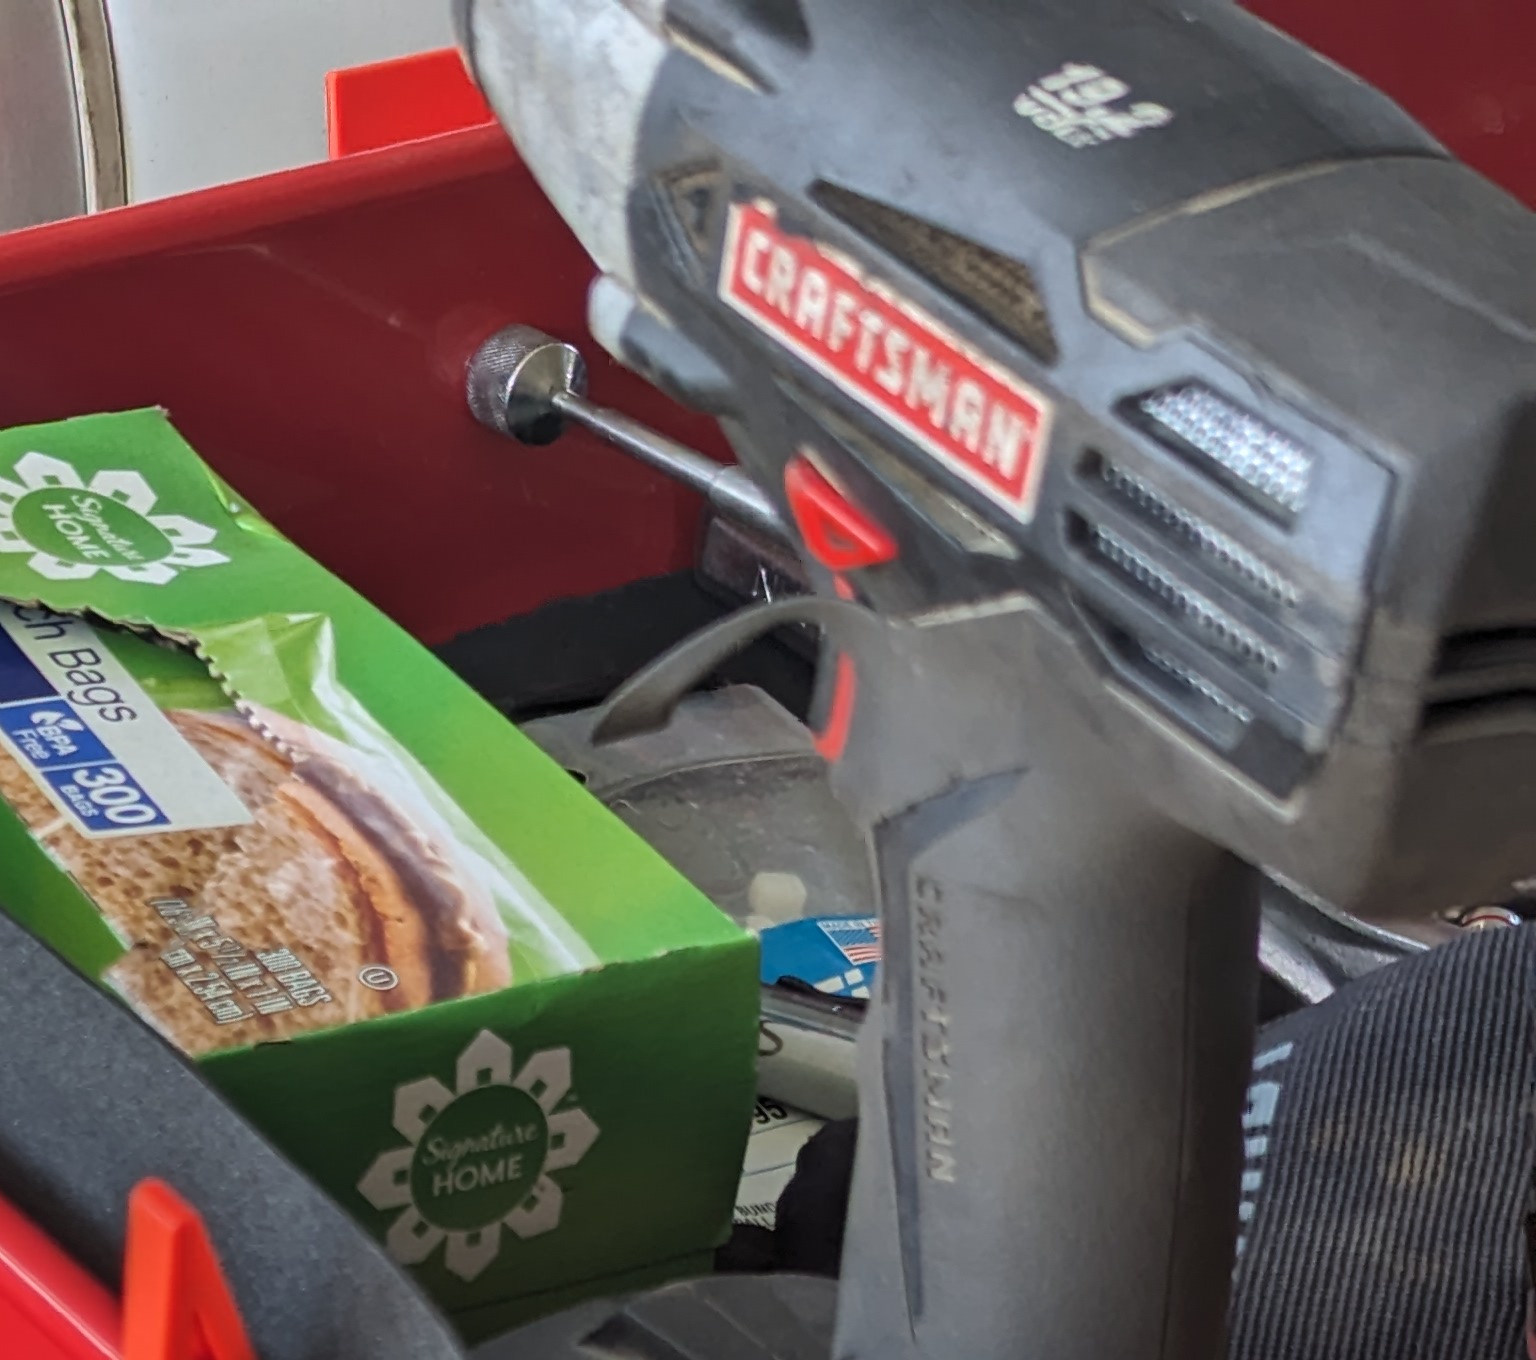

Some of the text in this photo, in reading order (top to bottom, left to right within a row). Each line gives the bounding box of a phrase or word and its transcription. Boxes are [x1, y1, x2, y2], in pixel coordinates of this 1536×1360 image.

[741, 228, 1027, 480] CRAFTSMAN
[41, 503, 111, 560] HOME
[47, 648, 138, 723] Bags
[13, 728, 51, 761] Free
[37, 723, 80, 757] BPA
[59, 783, 99, 818] BAGS
[72, 767, 157, 825] 300
[275, 969, 332, 1007] BAGS
[916, 875, 957, 1184] CRAFTSMAN
[422, 1122, 538, 1168] Signature
[433, 1153, 523, 1197] HOME
